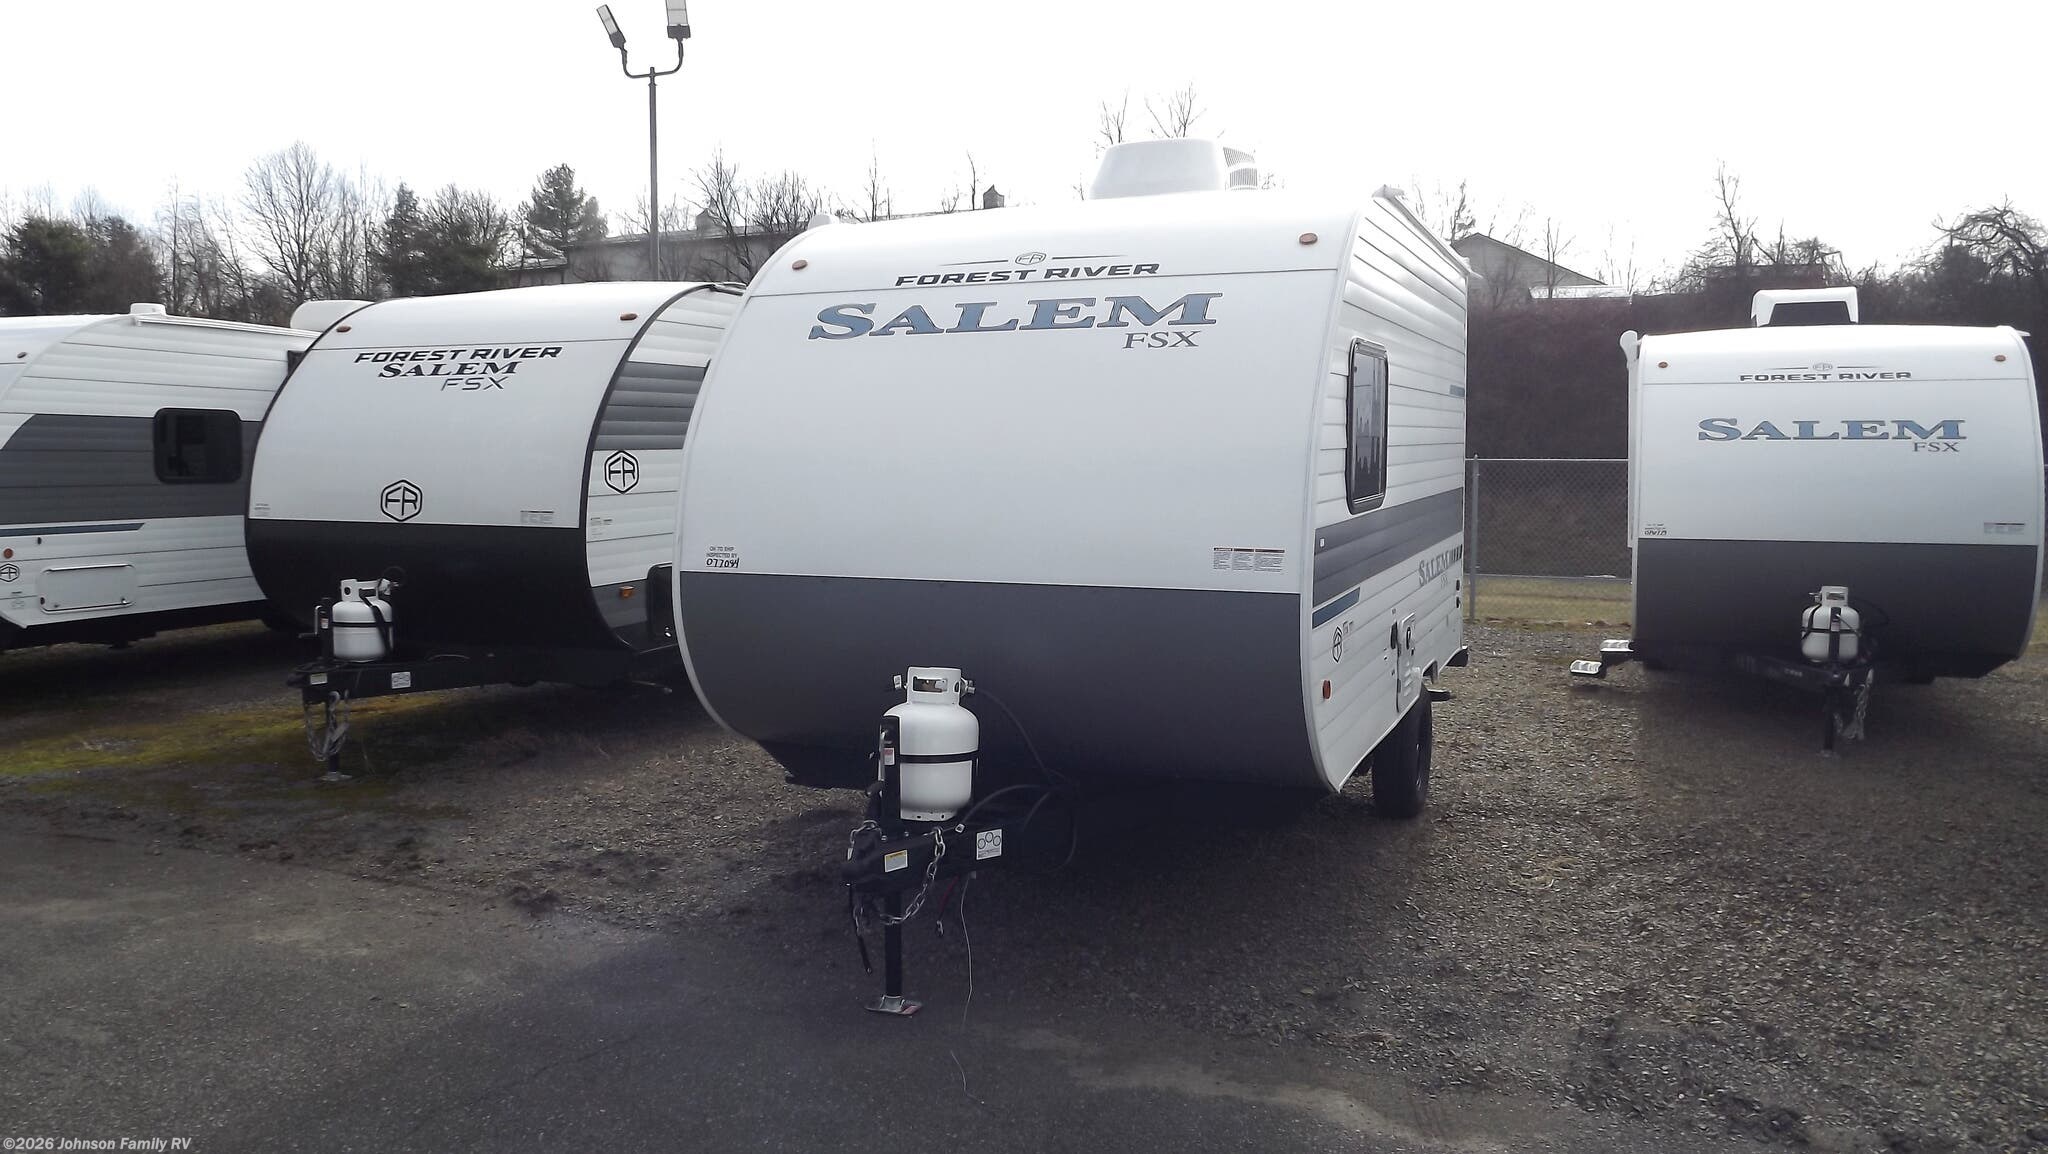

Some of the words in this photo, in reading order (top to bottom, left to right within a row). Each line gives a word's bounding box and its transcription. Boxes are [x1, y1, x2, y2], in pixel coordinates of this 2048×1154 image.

[895, 269, 1037, 286] FOREST
[1043, 263, 1160, 280] RIVER
[808, 292, 1223, 341] SALEM
[1122, 330, 1201, 350] FSX
[354, 350, 466, 363] FOREST
[470, 346, 563, 360] RIVER
[378, 361, 522, 378] SALEM
[1740, 373, 1832, 382] FOREST
[1838, 371, 1912, 380] RIVER
[441, 376, 509, 391] FSX
[1698, 418, 1967, 442] SALEM
[1913, 441, 1960, 453] FSX
